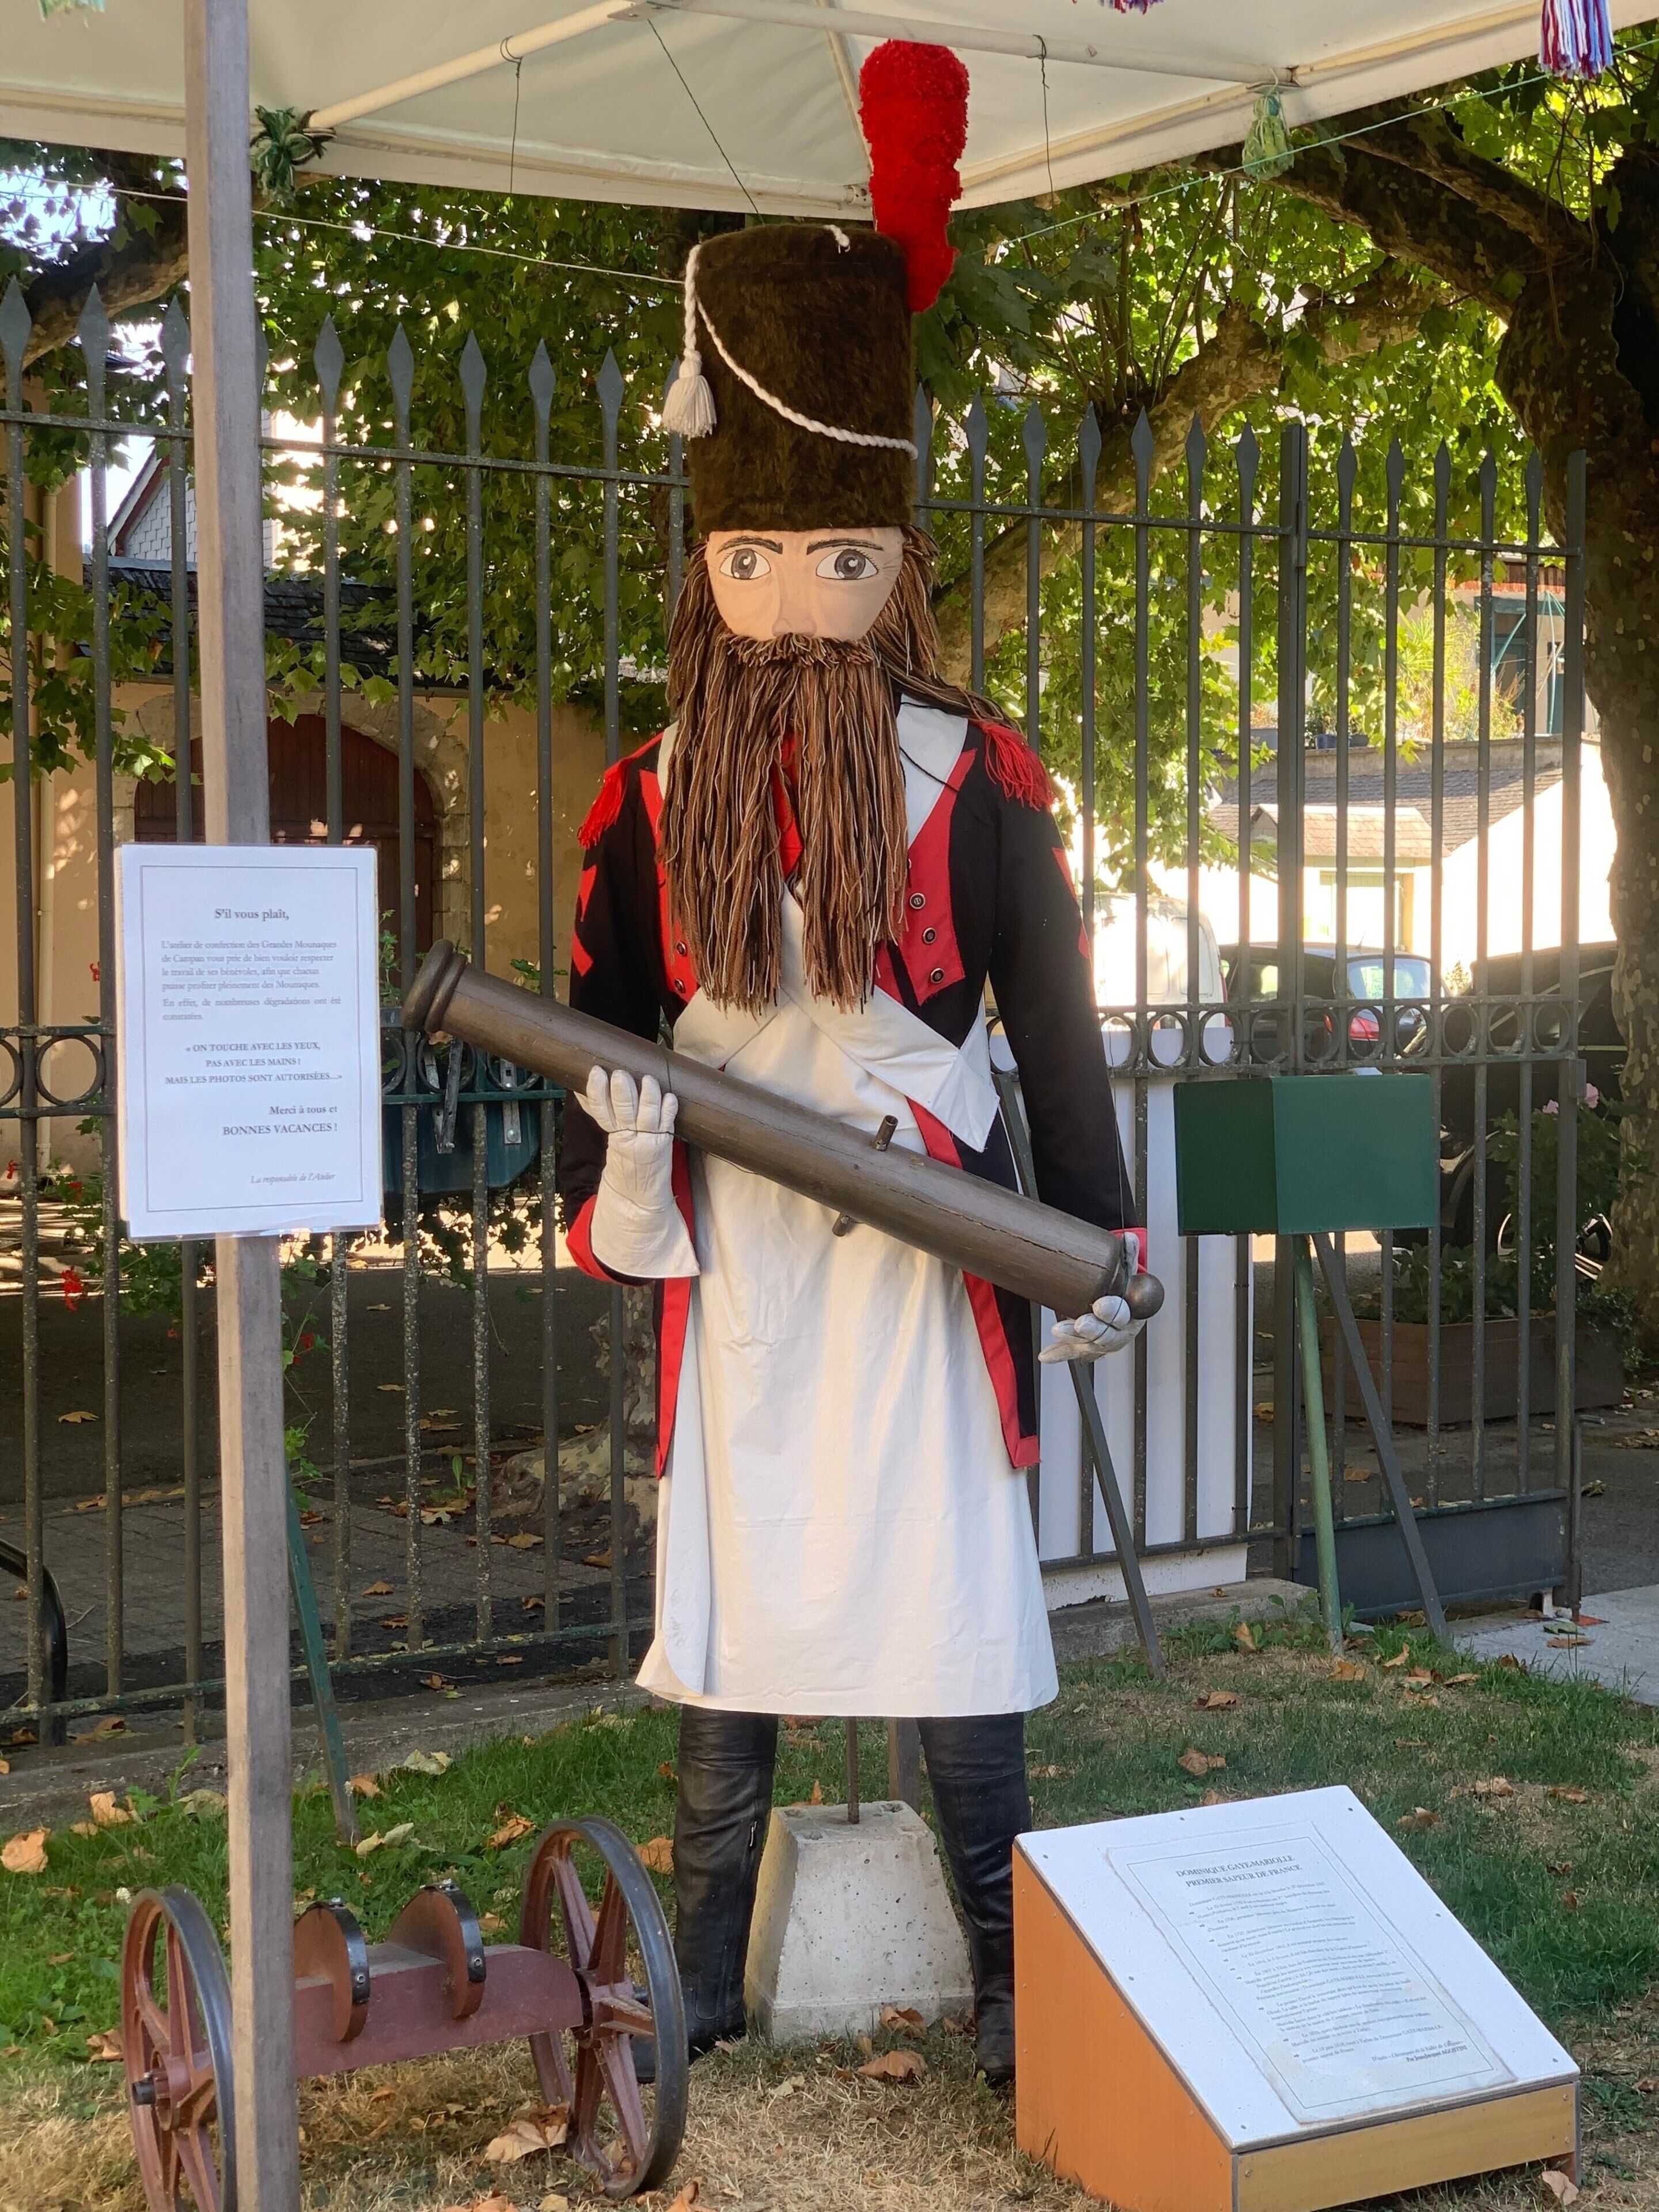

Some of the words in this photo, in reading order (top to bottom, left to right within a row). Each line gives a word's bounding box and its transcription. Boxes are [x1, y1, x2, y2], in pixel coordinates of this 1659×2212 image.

[214, 908, 232, 919] S'il
[235, 911, 259, 919] vous
[262, 908, 289, 922] plaît,
[194, 941, 203, 949] de
[247, 940, 259, 949] des
[262, 940, 293, 949] Grandes
[294, 940, 337, 950] Mounaques
[243, 954, 252, 962] de
[300, 955, 334, 964] respecter
[262, 980, 274, 988] des
[162, 998, 175, 1006] En
[202, 998, 211, 1006] de
[192, 1044, 207, 1052] ON
[210, 1043, 249, 1052] TOUCHE
[251, 1043, 275, 1051] AVEC
[294, 1041, 321, 1051] YEUX,
[205, 1059, 222, 1067] PAS
[224, 1059, 248, 1067] AVEC
[249, 1058, 266, 1066] LES
[267, 1058, 297, 1066] MAINS
[209, 1075, 247, 1084] PHOTOS
[248, 1074, 273, 1082] SONT
[268, 1105, 296, 1115] Merci
[222, 1124, 271, 1136] BONNES
[273, 1123, 332, 1134] VACANCES
[1176, 1865, 1229, 1877] DOMINIQUE
[1228, 1855, 1295, 1871] GAYE-MARIOLLE
[1185, 1877, 1223, 1888] PREMIER
[1223, 1872, 1256, 1883] SAPEUR
[1256, 1870, 1269, 1878] DE
[1268, 1864, 1302, 1876] FRANCE
